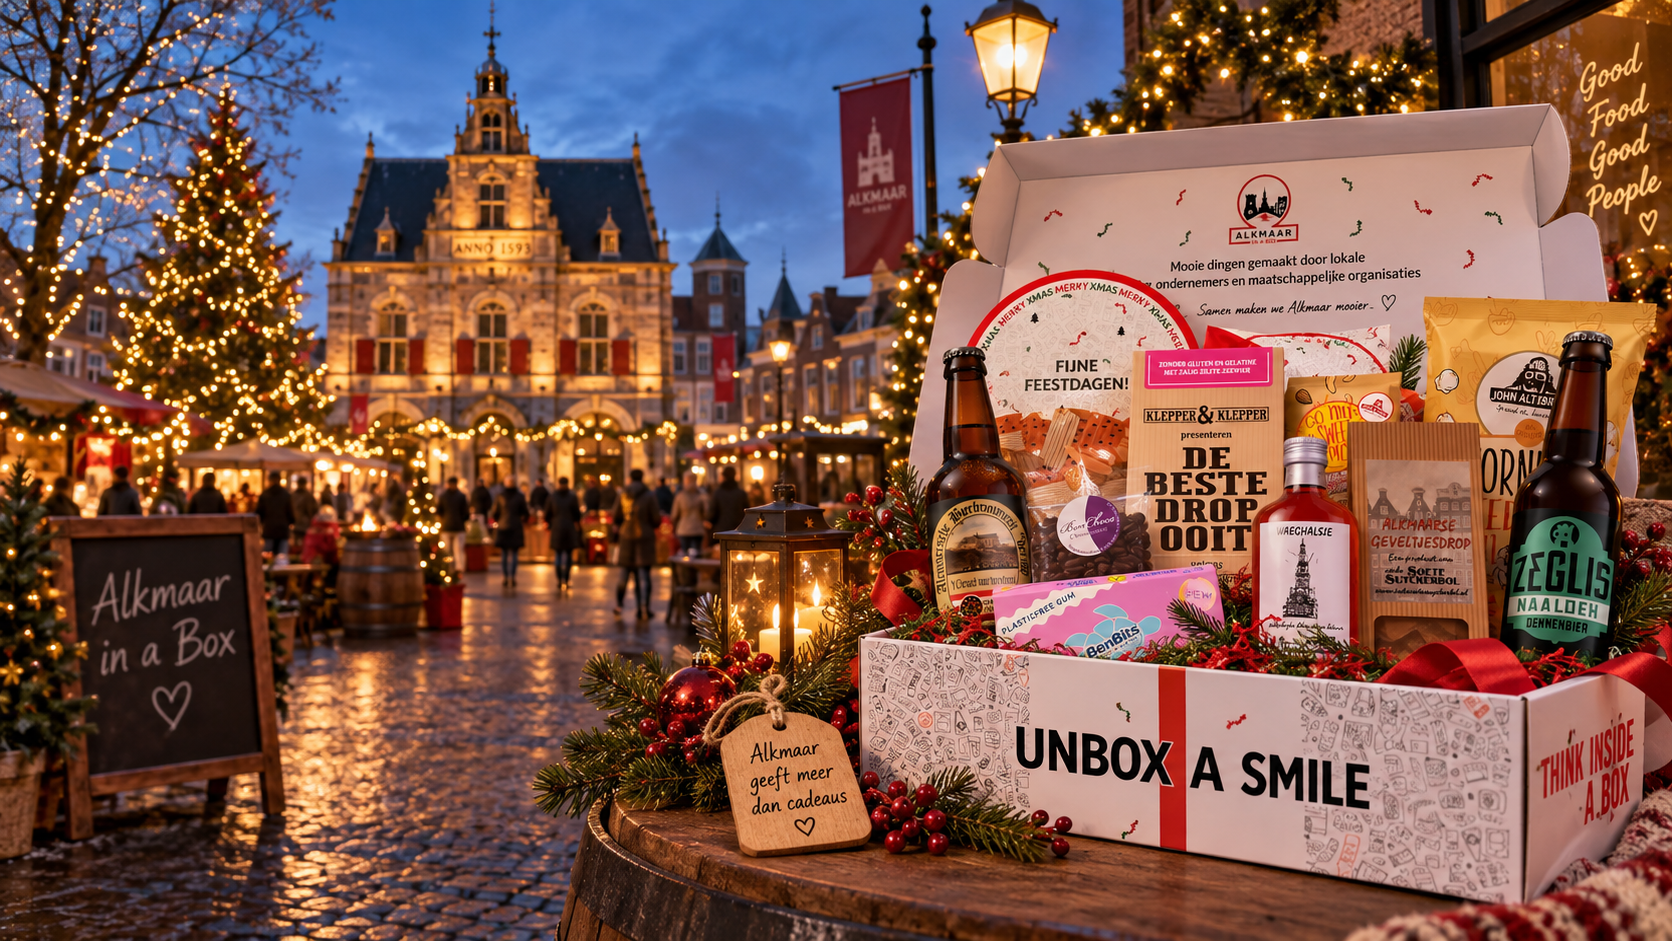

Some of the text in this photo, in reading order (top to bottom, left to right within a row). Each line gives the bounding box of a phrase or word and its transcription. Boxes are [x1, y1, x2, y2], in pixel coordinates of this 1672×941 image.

[1580, 42, 1643, 102] Good
[1587, 83, 1650, 138] Food
[1589, 123, 1650, 180] Good
[848, 184, 907, 208] ALKMAAR
[1586, 165, 1662, 218] People
[1235, 229, 1292, 239] ALKMAAR
[454, 243, 531, 255] ANNO 1593
[1170, 251, 1365, 272] Mooie dingen gemaakt door lokale
[1155, 277, 1229, 290] ondernemers
[1231, 277, 1246, 287] en
[1348, 267, 1422, 283] organisaties
[1026, 288, 1054, 305] XMAS
[1089, 282, 1119, 294] XMAS
[1197, 303, 1231, 317] Samen
[1235, 303, 1267, 315] maken
[1287, 300, 1332, 315] Alkmaar
[1055, 359, 1098, 373] FIJNE
[1024, 377, 1129, 391] FEESTDAGEN!
[1491, 391, 1517, 402] JOHN
[1146, 405, 1267, 425] KLEPPER & KLEPPER
[1181, 431, 1232, 441] presenteren
[1317, 420, 1347, 445] SWEE
[1182, 447, 1230, 469] DE
[1144, 471, 1267, 496] BESTE
[1155, 498, 1258, 523] DROP
[1382, 518, 1456, 532] ALKMAARSE
[1160, 525, 1252, 552] OOIT
[1371, 535, 1471, 550] GEVELTJESDROP
[1512, 550, 1611, 600] ZEGLIS
[91, 567, 231, 626] Alkmaar
[1001, 602, 1055, 635] PLASTICFREE
[1056, 591, 1076, 606] GUM
[1526, 617, 1588, 634] DENNENBIER
[101, 617, 236, 676] in a Box
[1086, 624, 1140, 658] BenBits
[750, 741, 819, 764] Alkmaar
[1540, 718, 1634, 799] THINK INSIDE
[1015, 726, 1370, 810] UNBOX A SMILE
[750, 766, 834, 796] geeft meer
[752, 789, 847, 815] dan cadeaus
